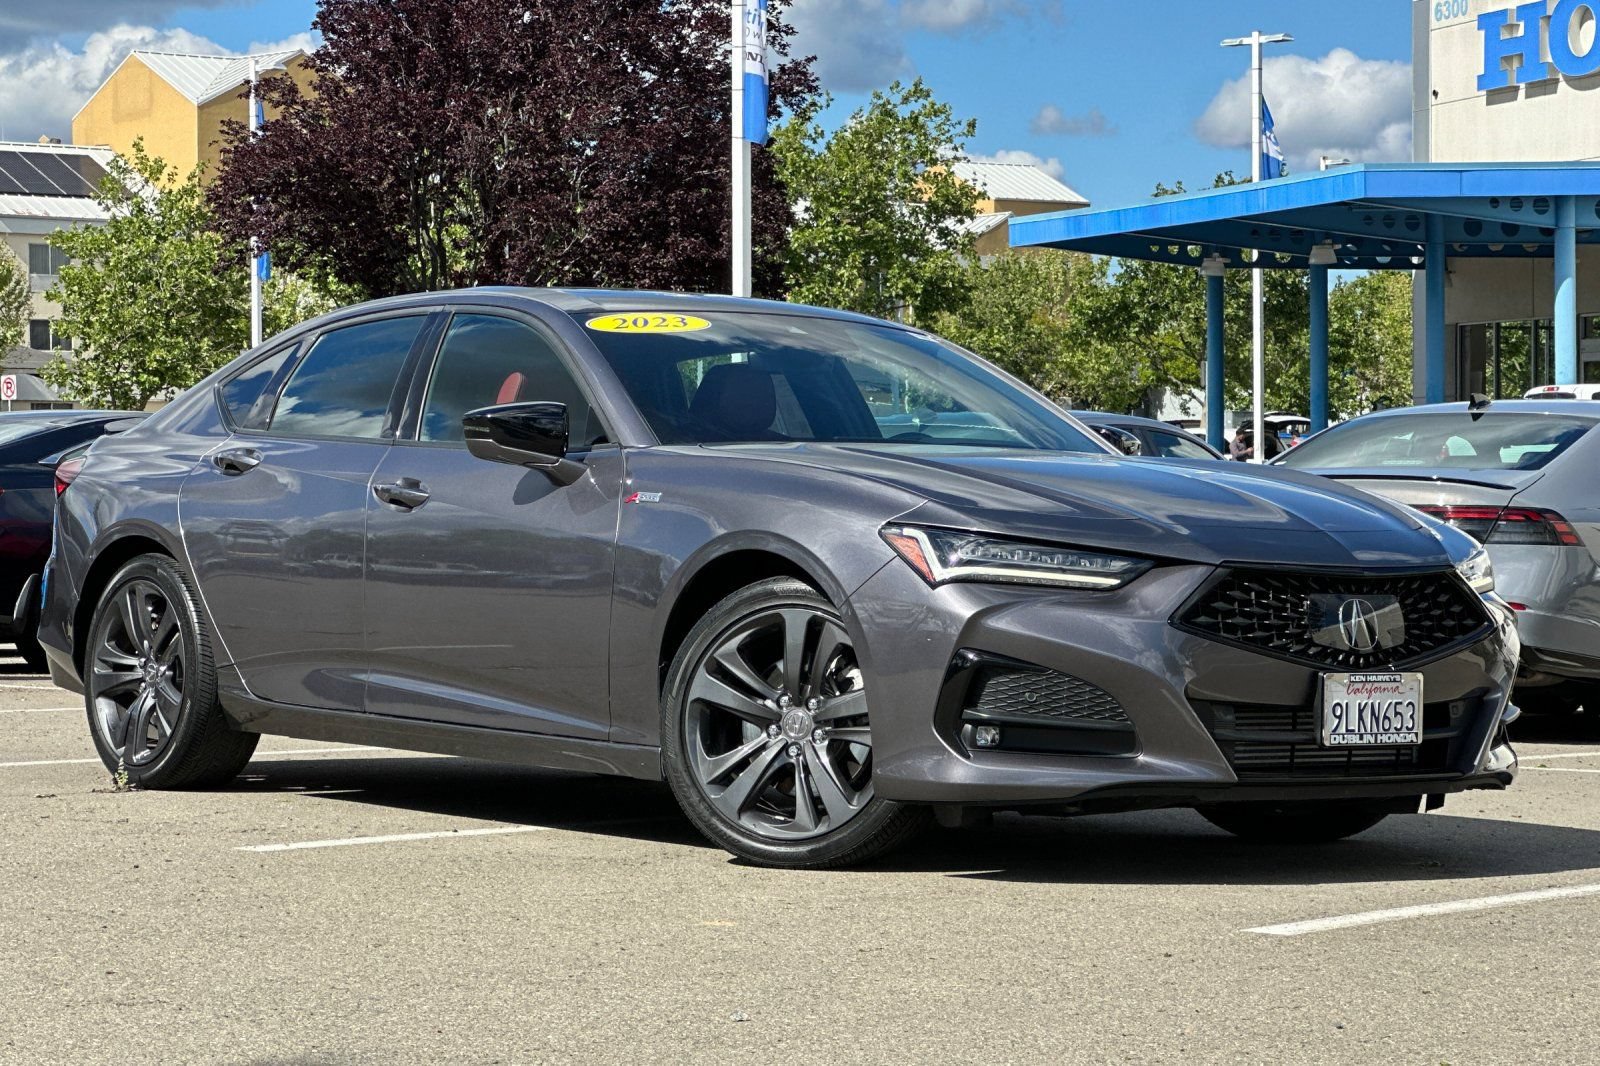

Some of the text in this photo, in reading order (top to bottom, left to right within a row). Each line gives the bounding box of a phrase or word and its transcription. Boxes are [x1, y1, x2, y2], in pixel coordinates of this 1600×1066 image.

[1434, 0, 1469, 22] 6300
[612, 316, 688, 330] 2023
[1346, 683, 1405, 699] California
[1331, 701, 1416, 733] 9LKN653
[1330, 733, 1418, 744] DUBLIN HONDA
